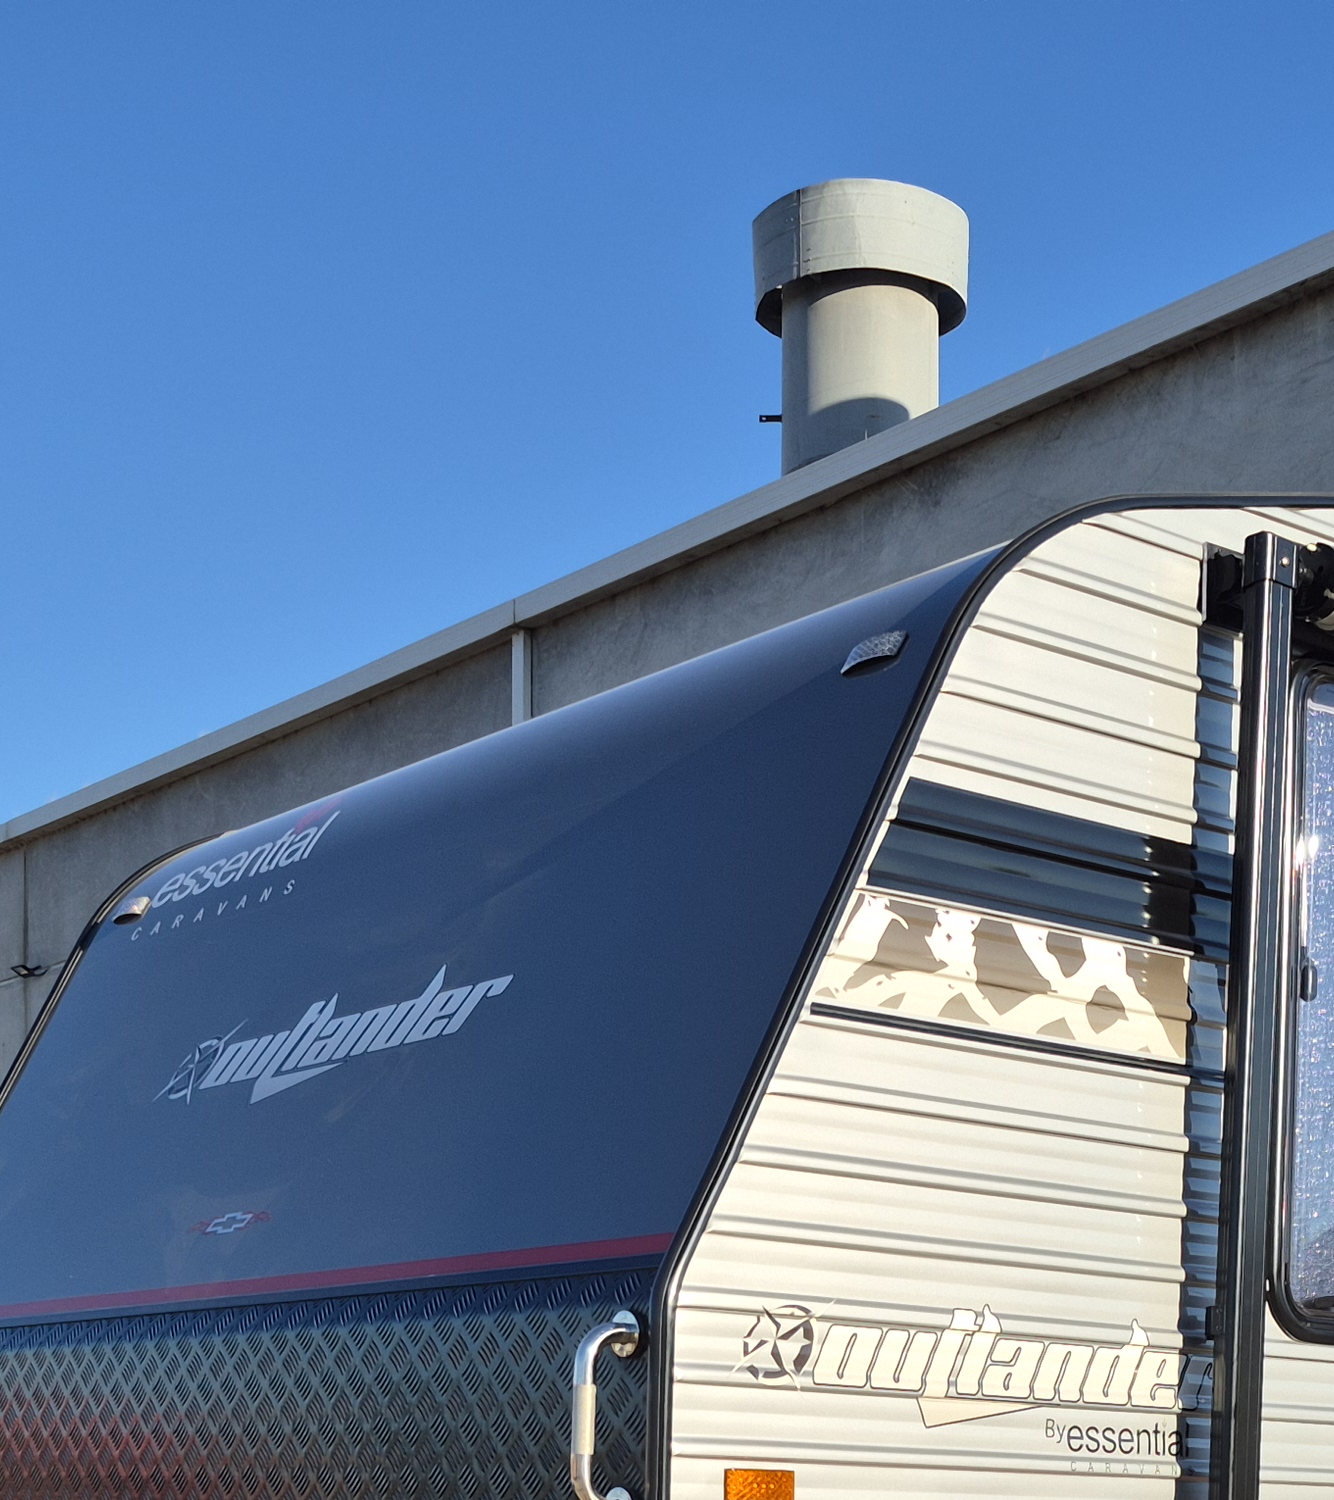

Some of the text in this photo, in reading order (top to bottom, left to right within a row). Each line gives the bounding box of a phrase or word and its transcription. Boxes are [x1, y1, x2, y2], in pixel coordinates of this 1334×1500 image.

[151, 810, 341, 909] essential
[130, 879, 296, 941] CARAVANS
[1045, 1418, 1189, 1457] By essential
[1070, 1460, 1194, 1476] CARAVANS
